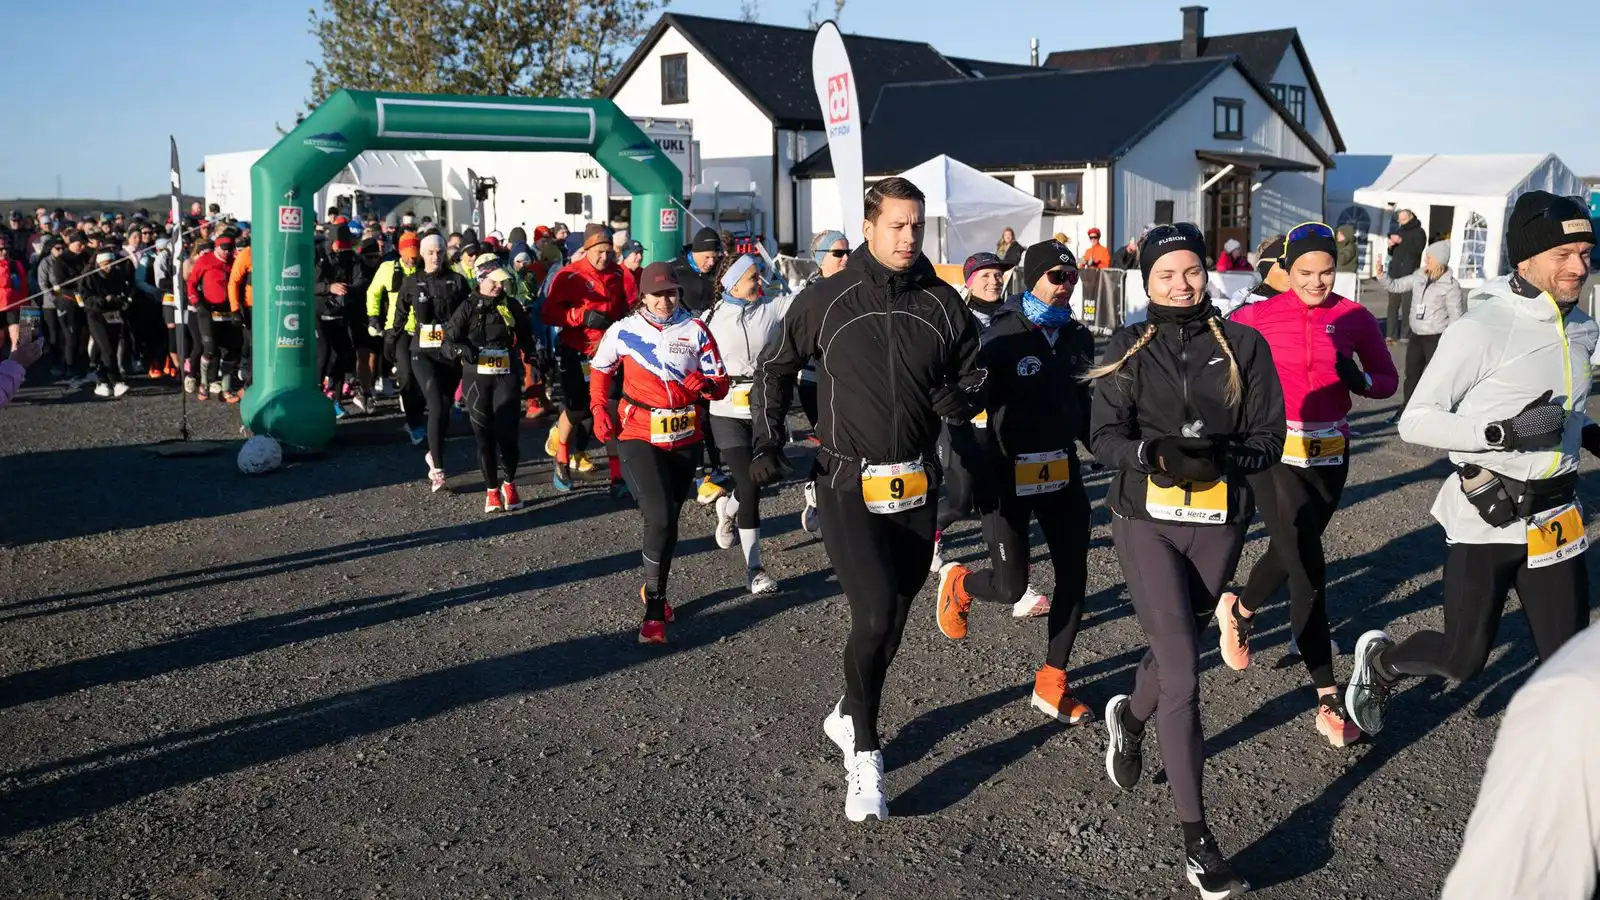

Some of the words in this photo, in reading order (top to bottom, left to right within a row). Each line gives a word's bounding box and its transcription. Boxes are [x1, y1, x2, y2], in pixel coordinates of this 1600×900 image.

[654, 138, 685, 151] KUKL
[575, 168, 600, 179] KUKL
[282, 208, 301, 225] 66
[663, 211, 677, 225] 66
[1158, 236, 1186, 246] FUSION
[283, 313, 300, 331] G
[277, 336, 305, 346] Hertz
[1309, 440, 1322, 457] 5
[1038, 464, 1049, 482] 4
[890, 478, 905, 499] 9
[1175, 509, 1183, 517] G
[1187, 510, 1207, 519] Hertz
[1550, 521, 1568, 548] 2
[1556, 550, 1563, 558] G
